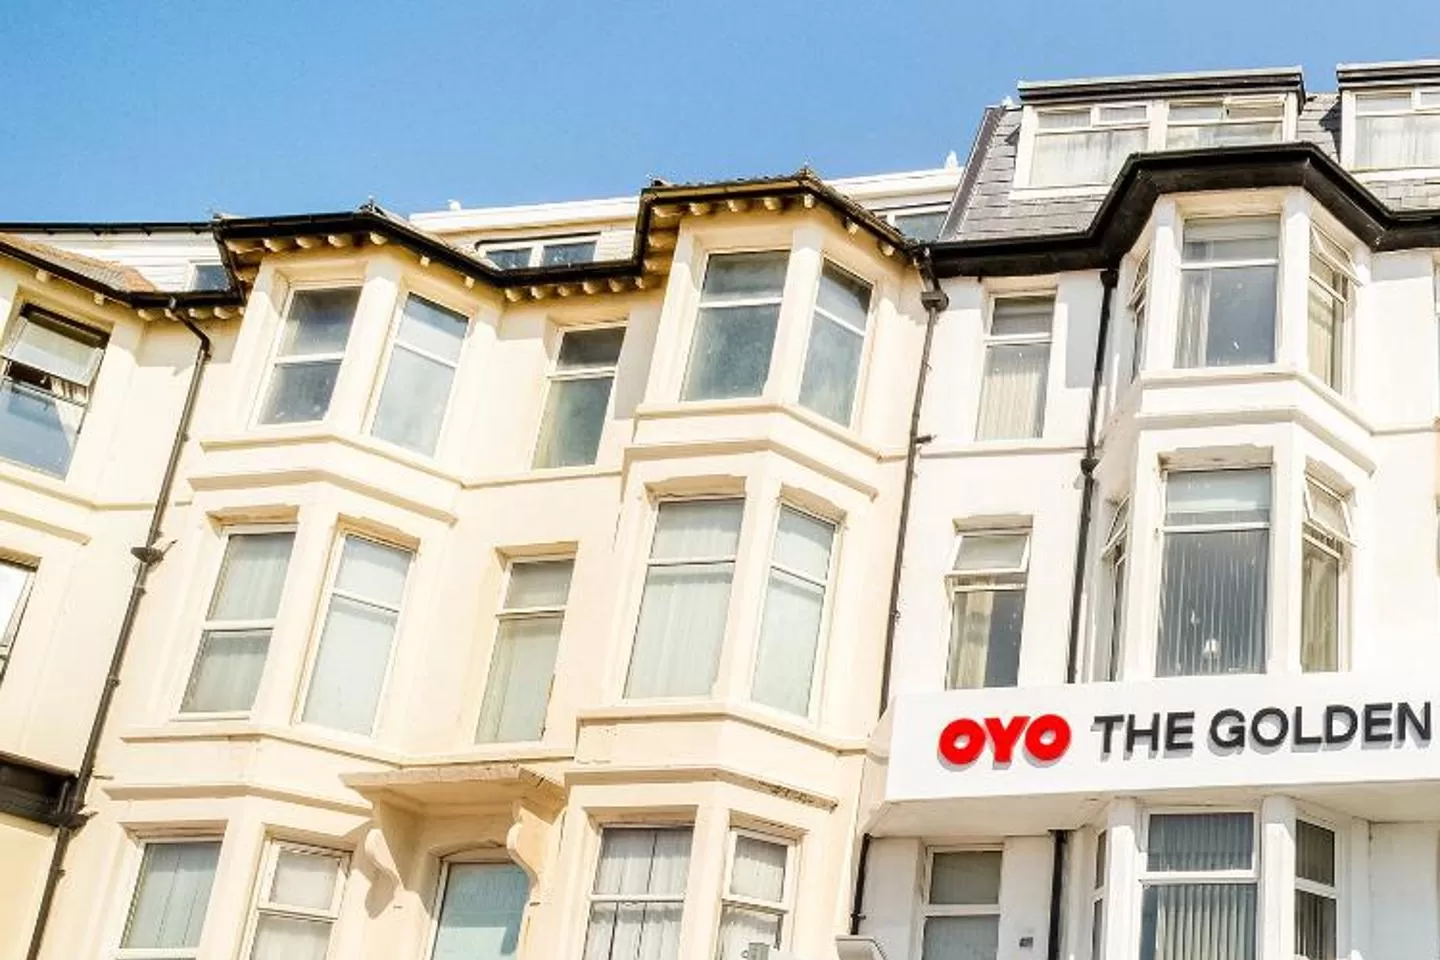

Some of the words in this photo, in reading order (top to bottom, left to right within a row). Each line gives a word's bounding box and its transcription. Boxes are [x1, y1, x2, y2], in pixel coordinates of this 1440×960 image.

[937, 713, 1073, 767] OYO
[1093, 711, 1195, 754] THE
[1209, 702, 1431, 749] GOLDEN
